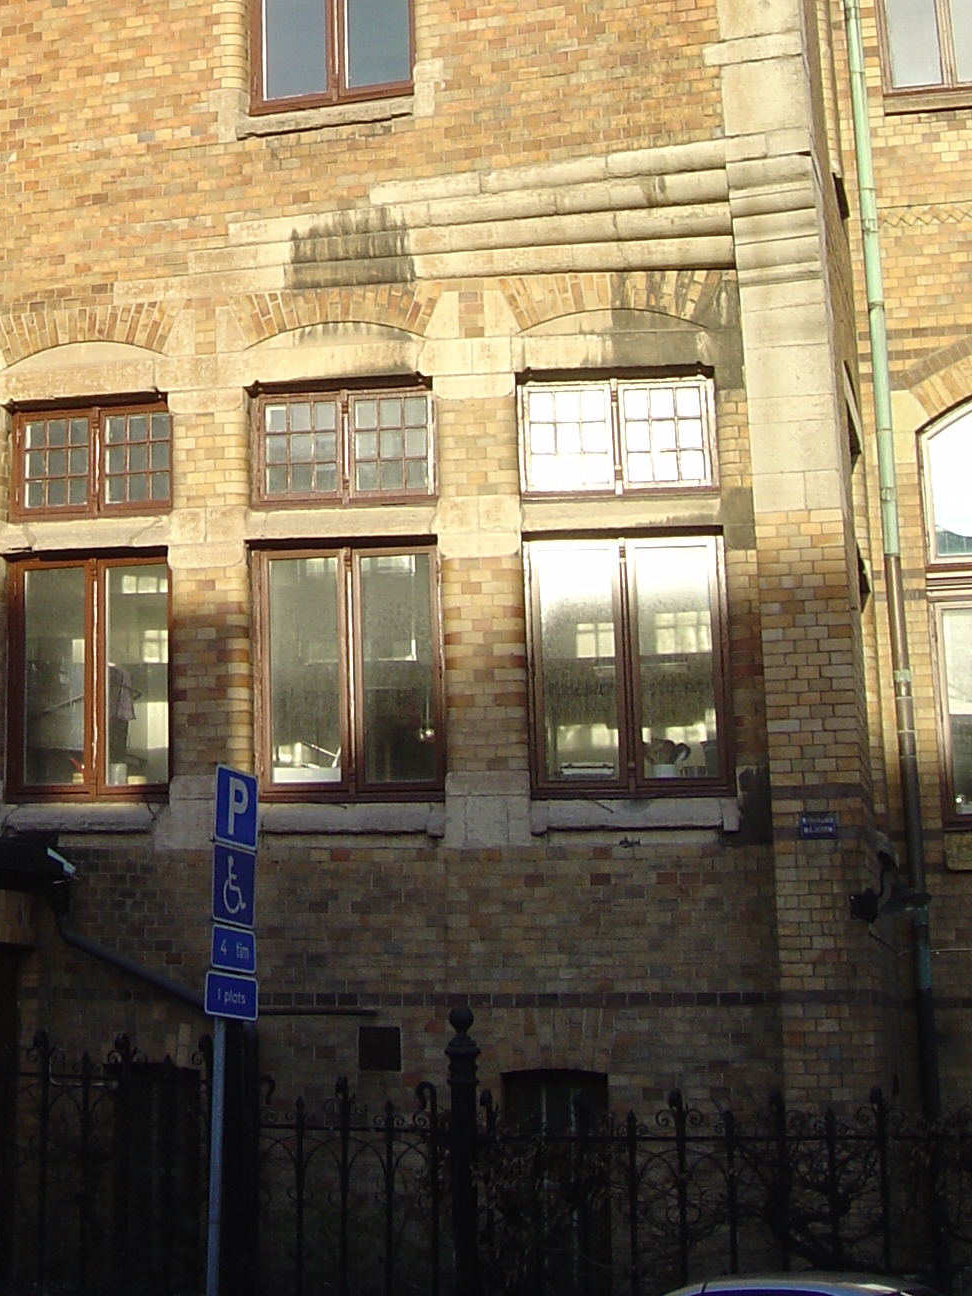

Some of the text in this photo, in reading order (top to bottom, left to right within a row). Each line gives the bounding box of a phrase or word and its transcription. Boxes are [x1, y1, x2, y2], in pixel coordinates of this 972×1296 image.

[228, 776, 248, 835] P
[220, 938, 250, 960] 4 tim
[224, 990, 246, 1005] plats
